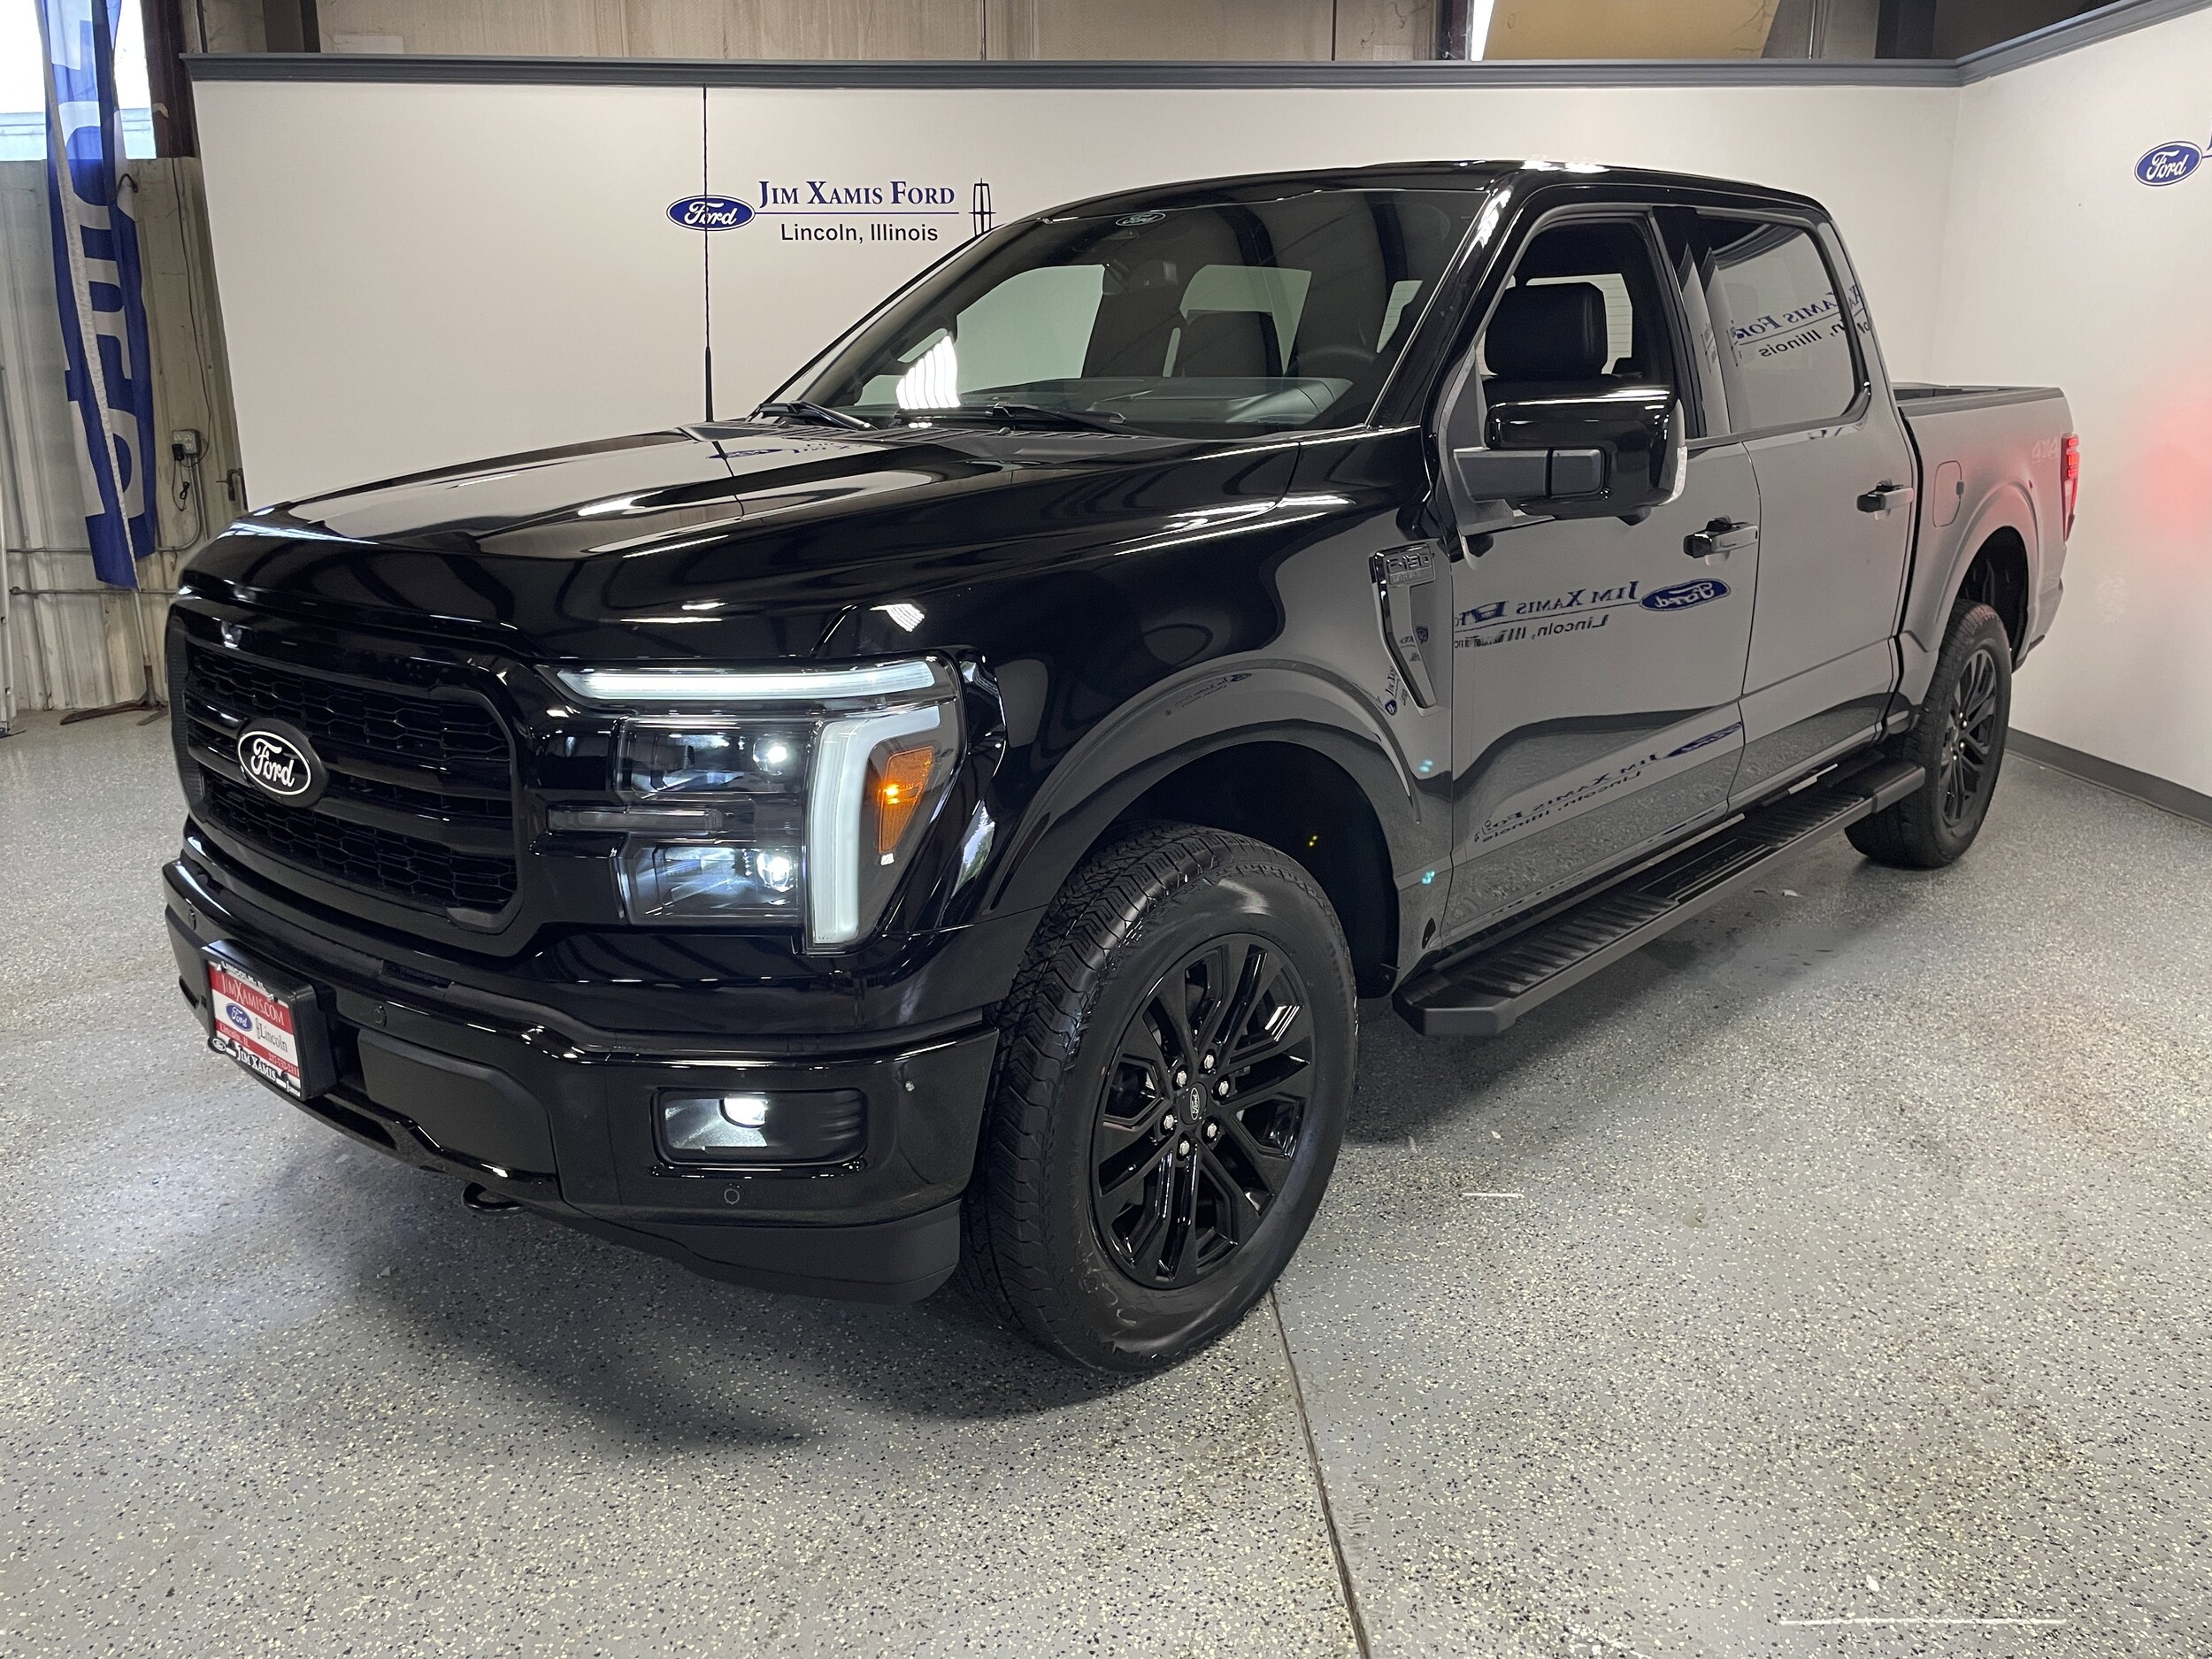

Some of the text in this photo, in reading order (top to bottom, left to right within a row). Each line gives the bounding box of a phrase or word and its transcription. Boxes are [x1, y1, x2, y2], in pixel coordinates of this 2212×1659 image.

[2146, 150, 2190, 180] Ford
[684, 200, 738, 226] Ford
[780, 223, 939, 244] Lincoln, Illinois
[250, 737, 296, 787] Ford
[231, 1006, 249, 1028] Ford
[258, 1022, 288, 1052] Lincoln
